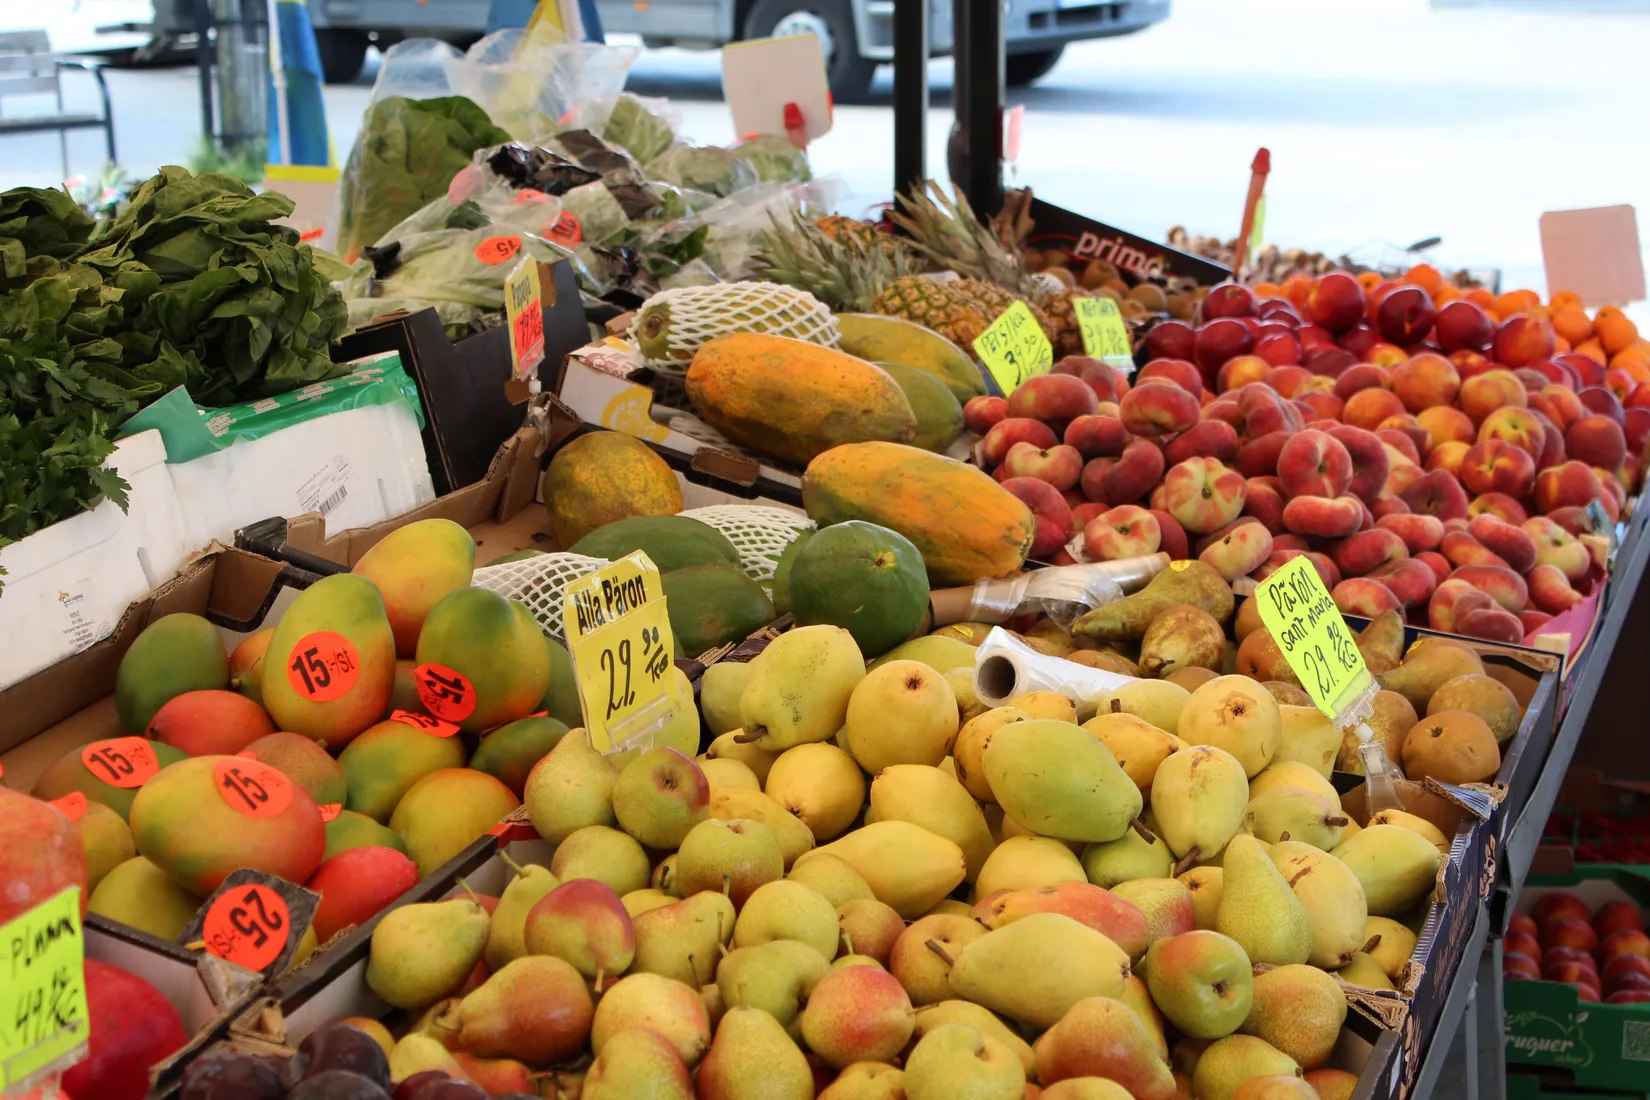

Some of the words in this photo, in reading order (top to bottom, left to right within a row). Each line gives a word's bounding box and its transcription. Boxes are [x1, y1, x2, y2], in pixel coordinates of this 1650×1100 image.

[574, 588, 607, 636] Alla
[601, 574, 647, 619] Päron
[1505, 1034, 1575, 1058] ruguer
